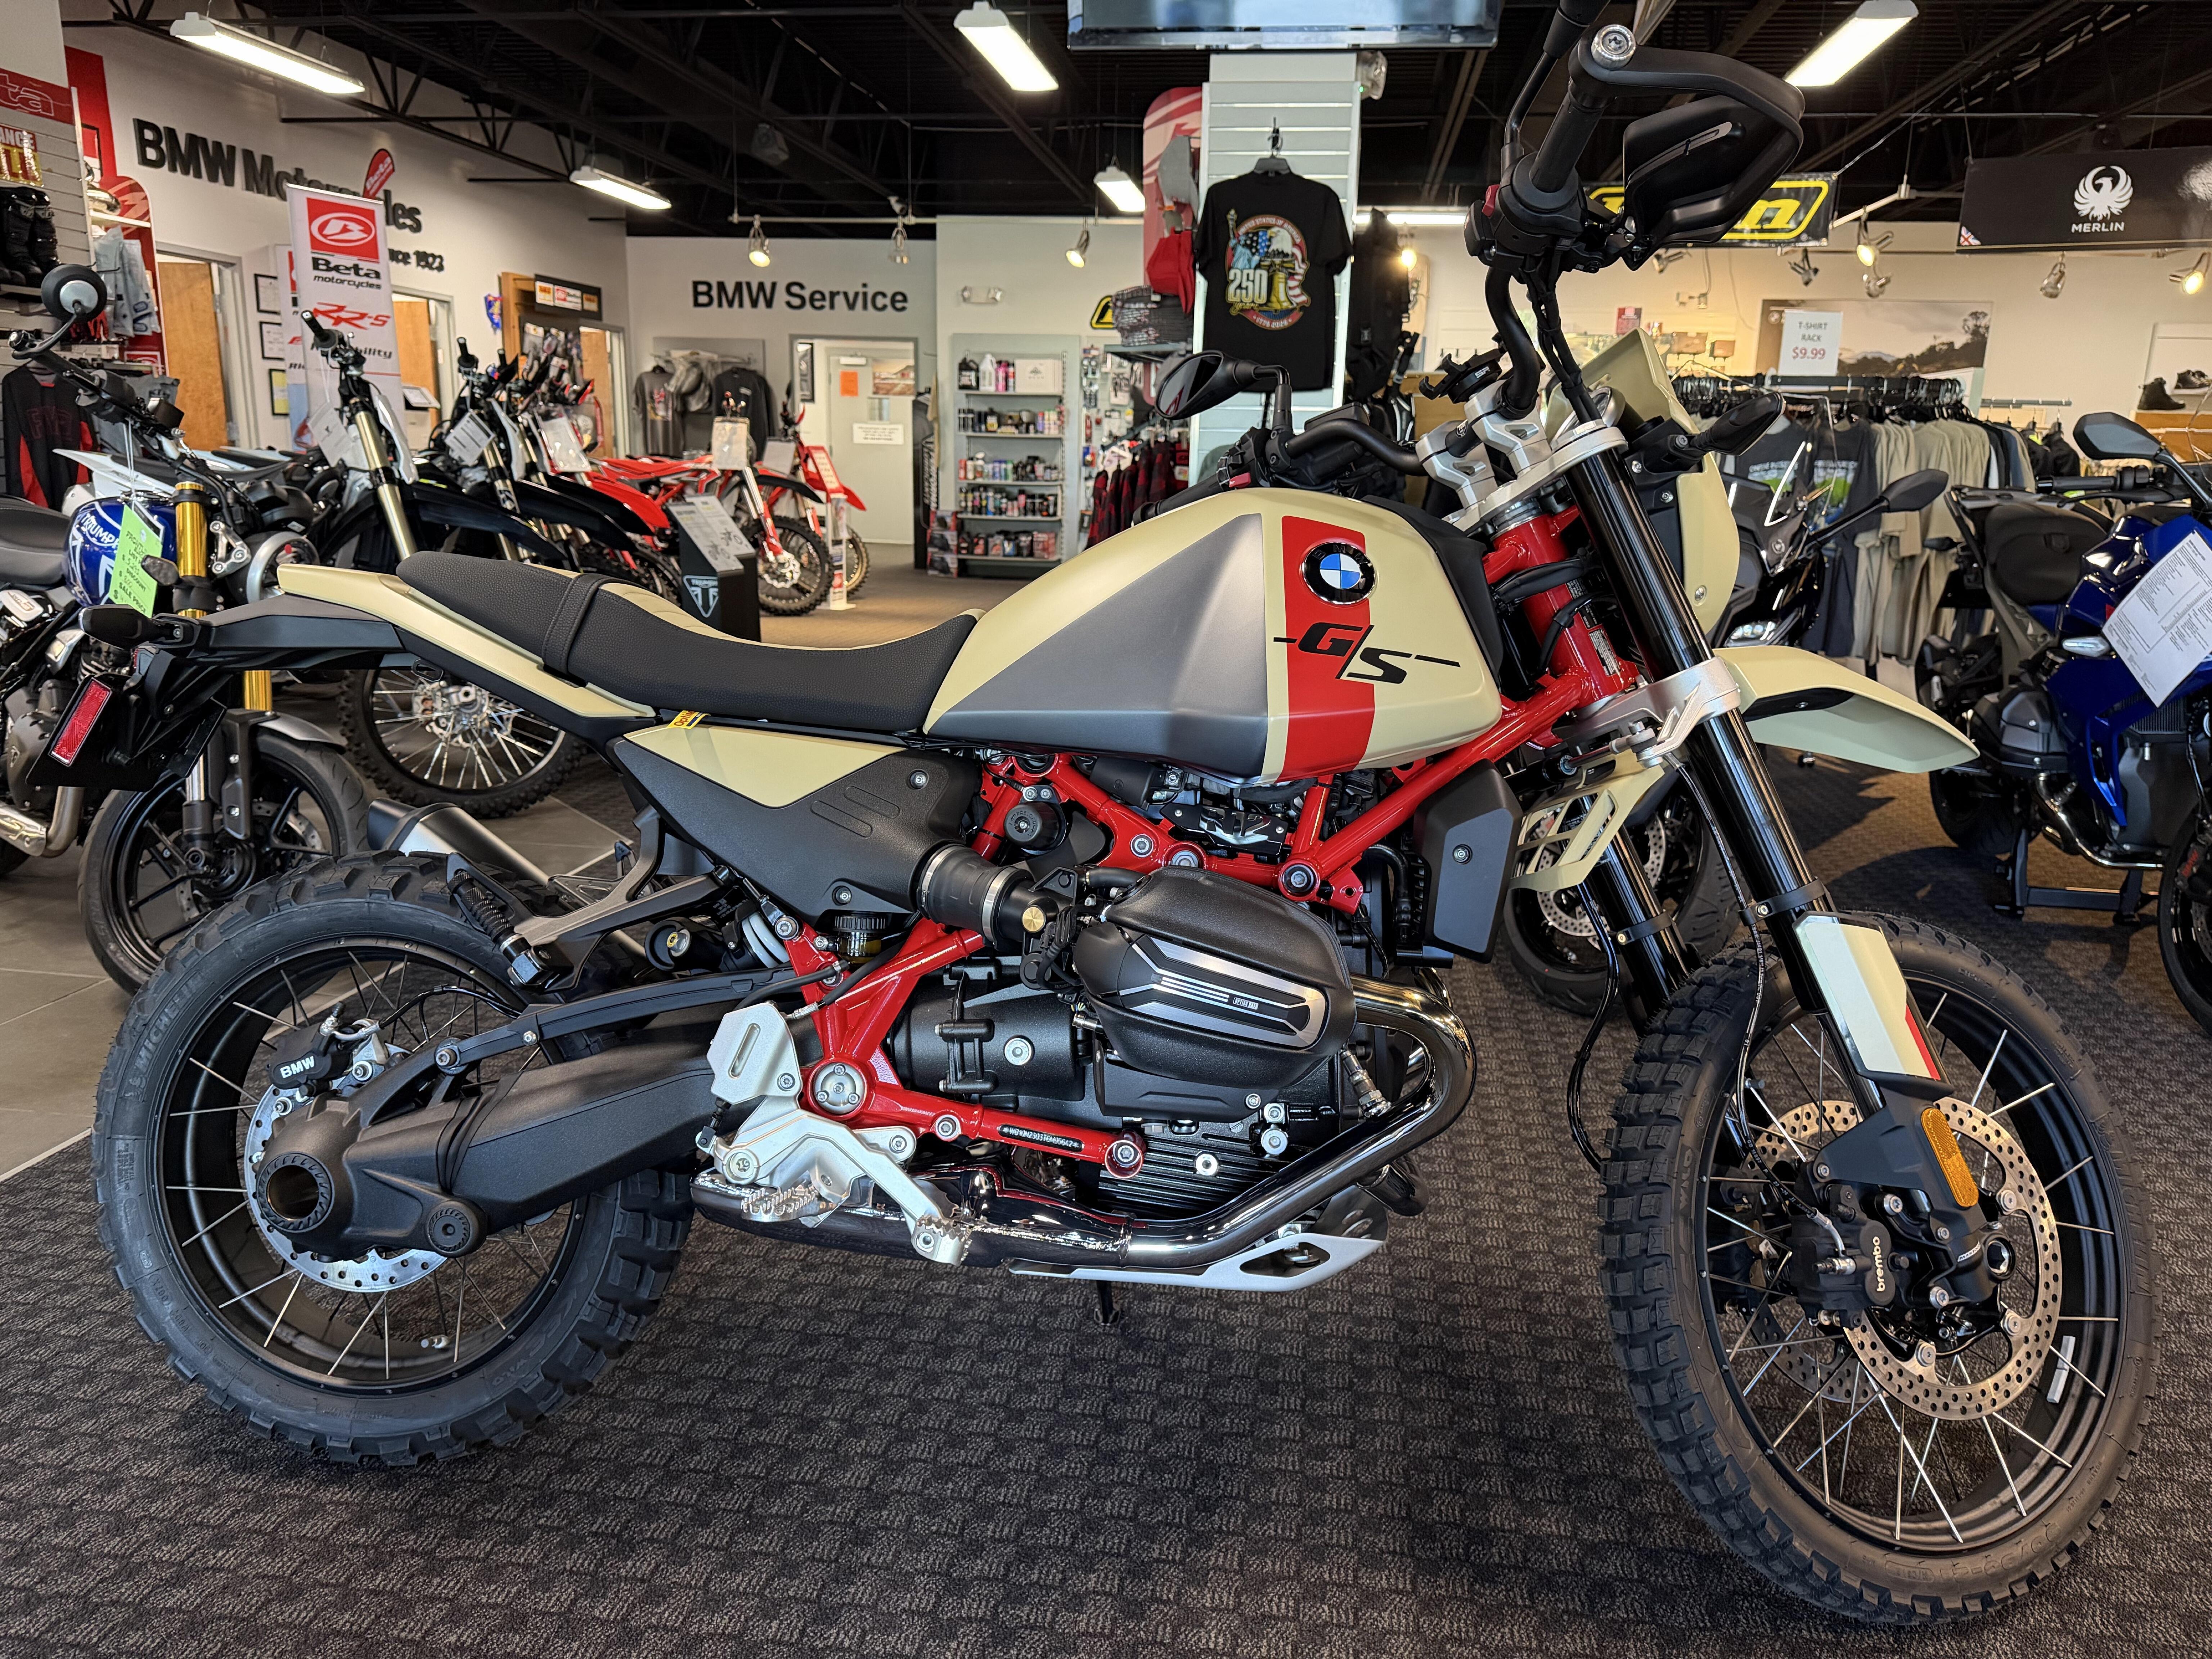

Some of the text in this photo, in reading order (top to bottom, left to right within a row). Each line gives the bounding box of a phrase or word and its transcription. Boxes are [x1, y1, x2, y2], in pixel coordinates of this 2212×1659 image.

[133, 118, 236, 187] BMW
[2071, 222, 2124, 233] MERLIN
[312, 257, 381, 279] Beta
[314, 275, 381, 289] motorcycles
[1228, 269, 1268, 304] 250
[692, 280, 908, 312] BMW Service
[1798, 322, 1827, 330] T-SHIRT
[1801, 334, 1821, 342] RACK
[1792, 346, 1826, 360] $9.99
[1312, 544, 1371, 564] BMW
[280, 1056, 315, 1078] BMW
[1872, 1236, 1885, 1292] brembo
